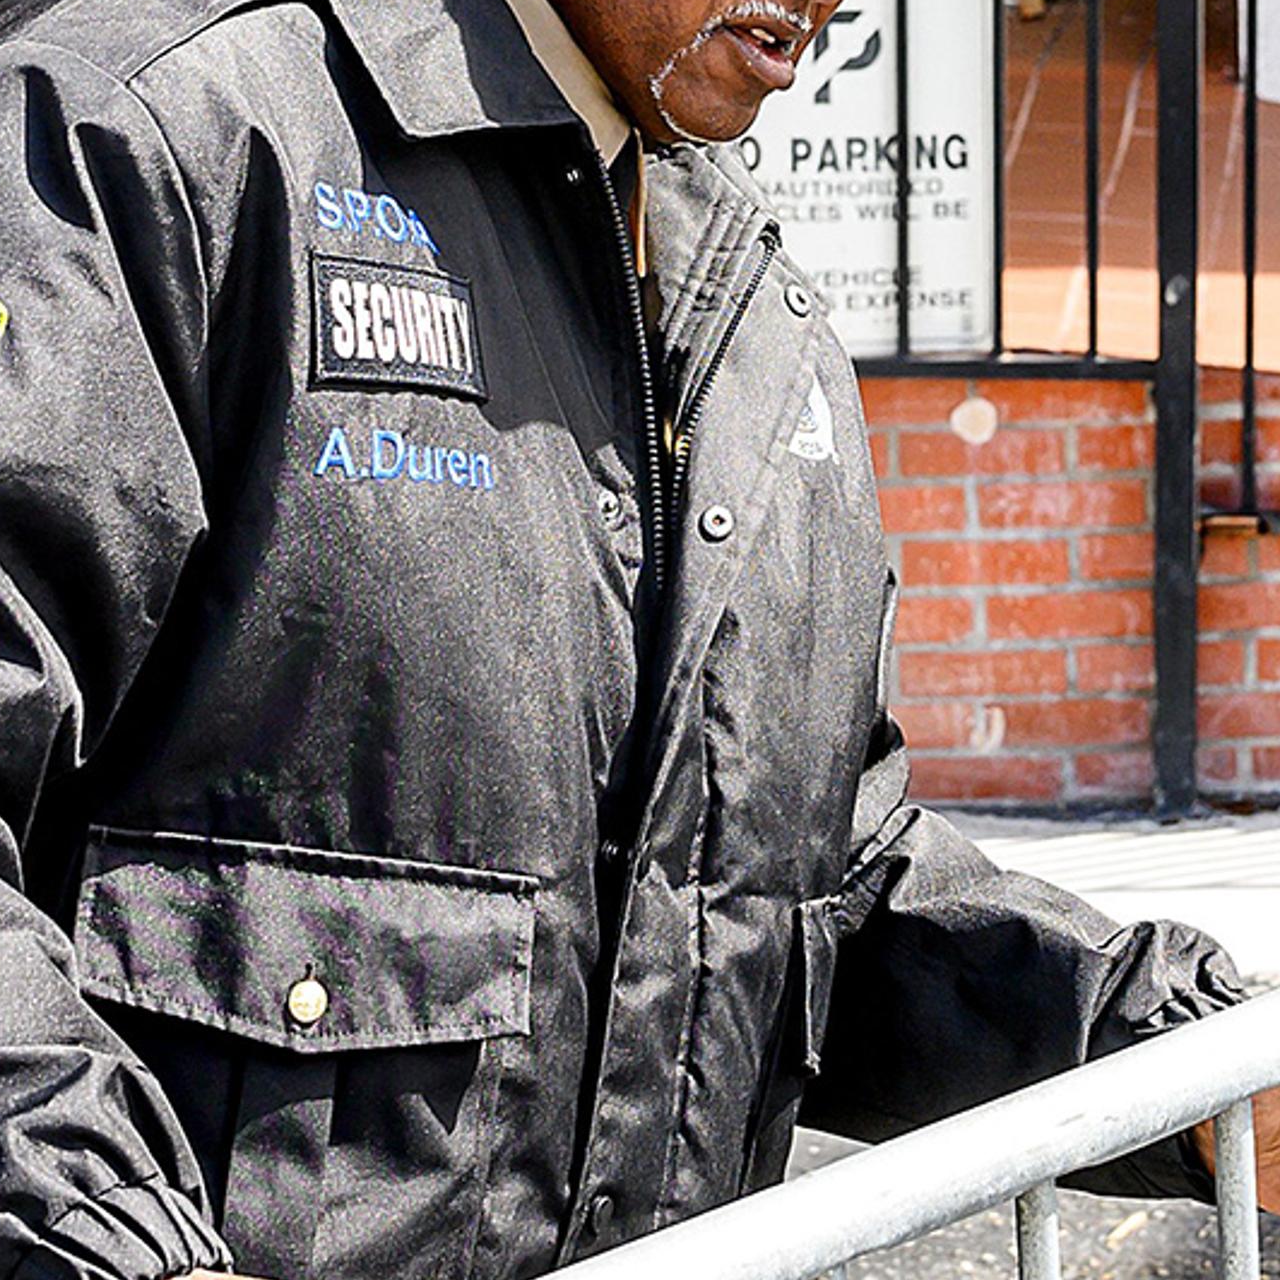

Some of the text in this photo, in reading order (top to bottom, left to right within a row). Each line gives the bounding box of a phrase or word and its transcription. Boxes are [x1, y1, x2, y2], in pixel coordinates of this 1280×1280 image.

[791, 134, 968, 172] PARKNG
[933, 200, 968, 220] BE
[330, 277, 472, 373] SECURITY
[312, 426, 494, 491] A.Duren
